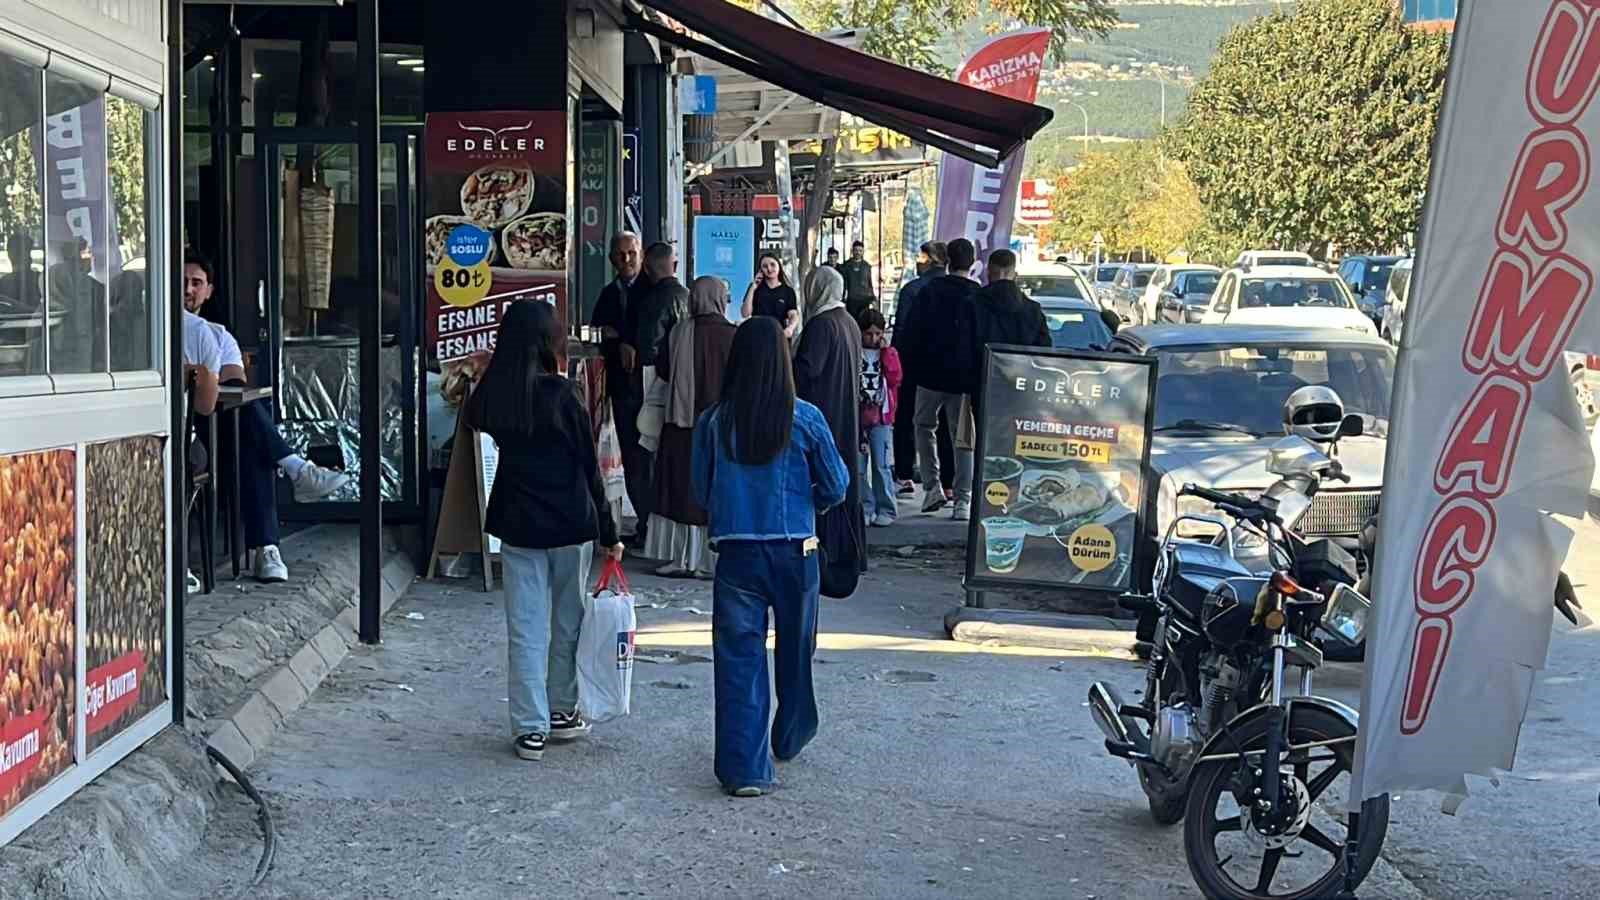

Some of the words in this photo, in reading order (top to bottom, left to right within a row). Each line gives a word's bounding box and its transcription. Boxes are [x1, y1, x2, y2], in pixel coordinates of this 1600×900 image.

[967, 51, 1041, 84] KARİZMA
[447, 138, 545, 151] EDELER
[450, 244, 483, 254] SOSLU
[438, 304, 496, 332] EFSANE
[1400, 0, 1600, 735] URMACI
[1015, 377, 1121, 399] EDELER
[1015, 419, 1071, 434] YEMEDEN
[1073, 424, 1115, 439] GEÇME
[1021, 441, 1058, 452] SADECE
[1060, 442, 1090, 457] 150
[1074, 536, 1111, 547] Adana
[1072, 546, 1111, 559] Dürüm
[106, 667, 137, 704] Kavurma
[0, 728, 39, 775] Kavurma
